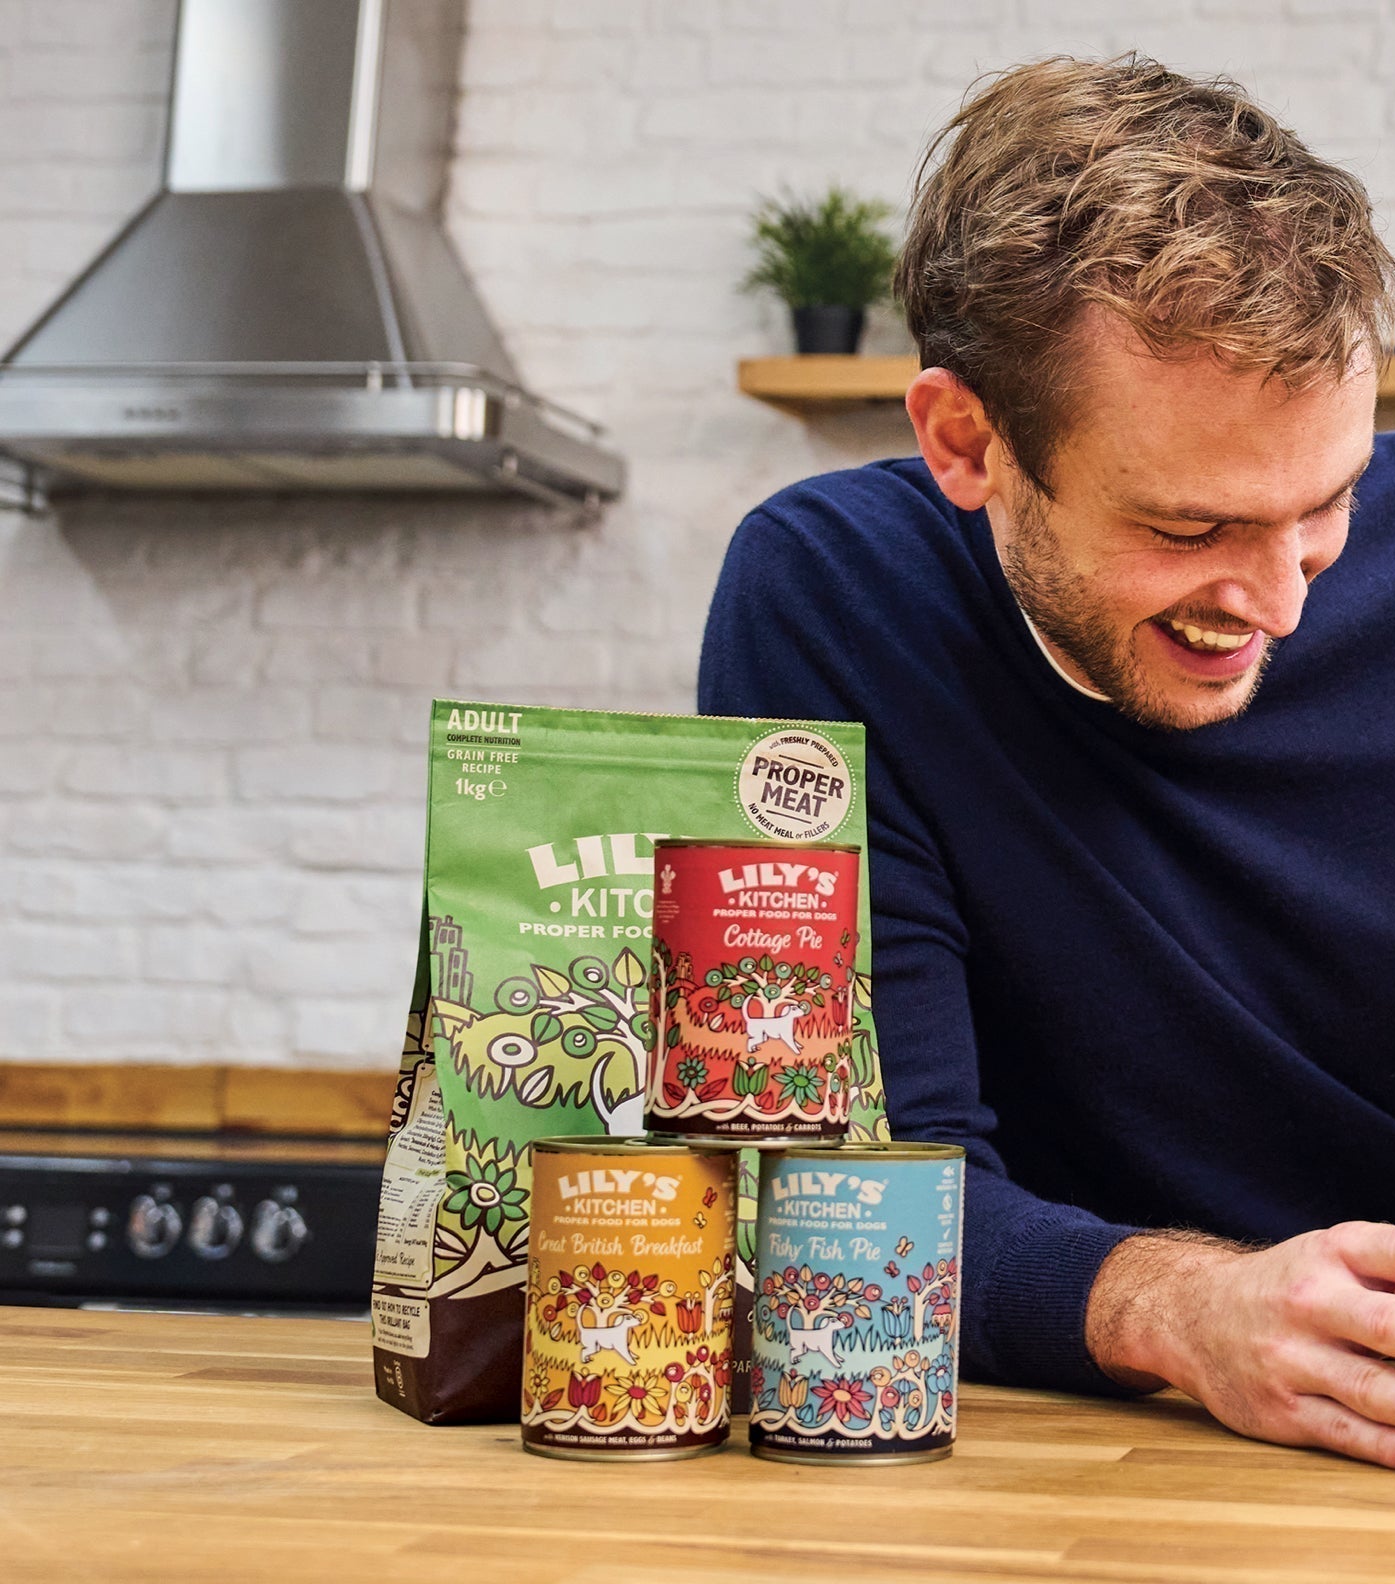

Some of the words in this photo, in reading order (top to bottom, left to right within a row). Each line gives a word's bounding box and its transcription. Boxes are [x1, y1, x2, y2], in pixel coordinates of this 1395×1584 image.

[447, 708, 523, 734] ADULT
[446, 733, 483, 744] COMPLETE
[484, 736, 521, 746] NUTRITION
[447, 749, 485, 761] GRAIN
[490, 751, 519, 764] FREE
[780, 736, 810, 745] FRESHLY
[810, 740, 839, 768] PREPARED
[462, 763, 502, 775] RECIPE
[752, 755, 845, 800] PROPER
[760, 781, 828, 818] MEAT
[748, 802, 760, 815] NO
[755, 813, 775, 831] MEAT
[773, 826, 795, 840] MEAL
[795, 832, 804, 840] or
[804, 821, 830, 839] FILLERS
[525, 832, 672, 890] LIL
[718, 862, 838, 897] LILY'S
[738, 890, 820, 909] KITCHEN
[713, 908, 757, 918] PROPER
[758, 909, 791, 920] FOOD
[792, 910, 813, 921] FOR
[814, 911, 838, 922] DOGS
[519, 922, 605, 939] PROPER
[723, 922, 792, 955] Cottage
[795, 924, 823, 950] Pie
[751, 1123, 785, 1132] POTATOES
[793, 1123, 822, 1132] CARROTS
[557, 1168, 681, 1201] LILY'S
[771, 1171, 888, 1205] LILY'S
[573, 1198, 656, 1216] KITCHEN
[784, 1200, 861, 1219] KITCHEN
[553, 1215, 589, 1225] PROPER
[591, 1216, 624, 1227] FOOD
[625, 1217, 649, 1227] FOR
[651, 1217, 681, 1227] DOGS
[768, 1216, 798, 1227] PROPER
[799, 1218, 829, 1229] FOOD
[830, 1220, 853, 1230] FOR
[856, 1221, 887, 1231] DOGS
[538, 1230, 567, 1252] Great
[570, 1232, 625, 1256] British
[629, 1233, 704, 1260] Breakfast
[768, 1232, 804, 1262] Fishy
[808, 1235, 845, 1261] Fish
[849, 1236, 881, 1261] Pie
[399, 1251, 416, 1269] Recipe
[401, 1304, 421, 1318] RECYCLE
[402, 1318, 411, 1330] BAG
[555, 1434, 579, 1443] VENISON
[579, 1435, 607, 1444] SAUSAGE
[628, 1436, 647, 1445] EGGS
[656, 1434, 677, 1444] BEANS
[798, 1437, 825, 1447] SALMON
[835, 1439, 873, 1448] POTATOES
